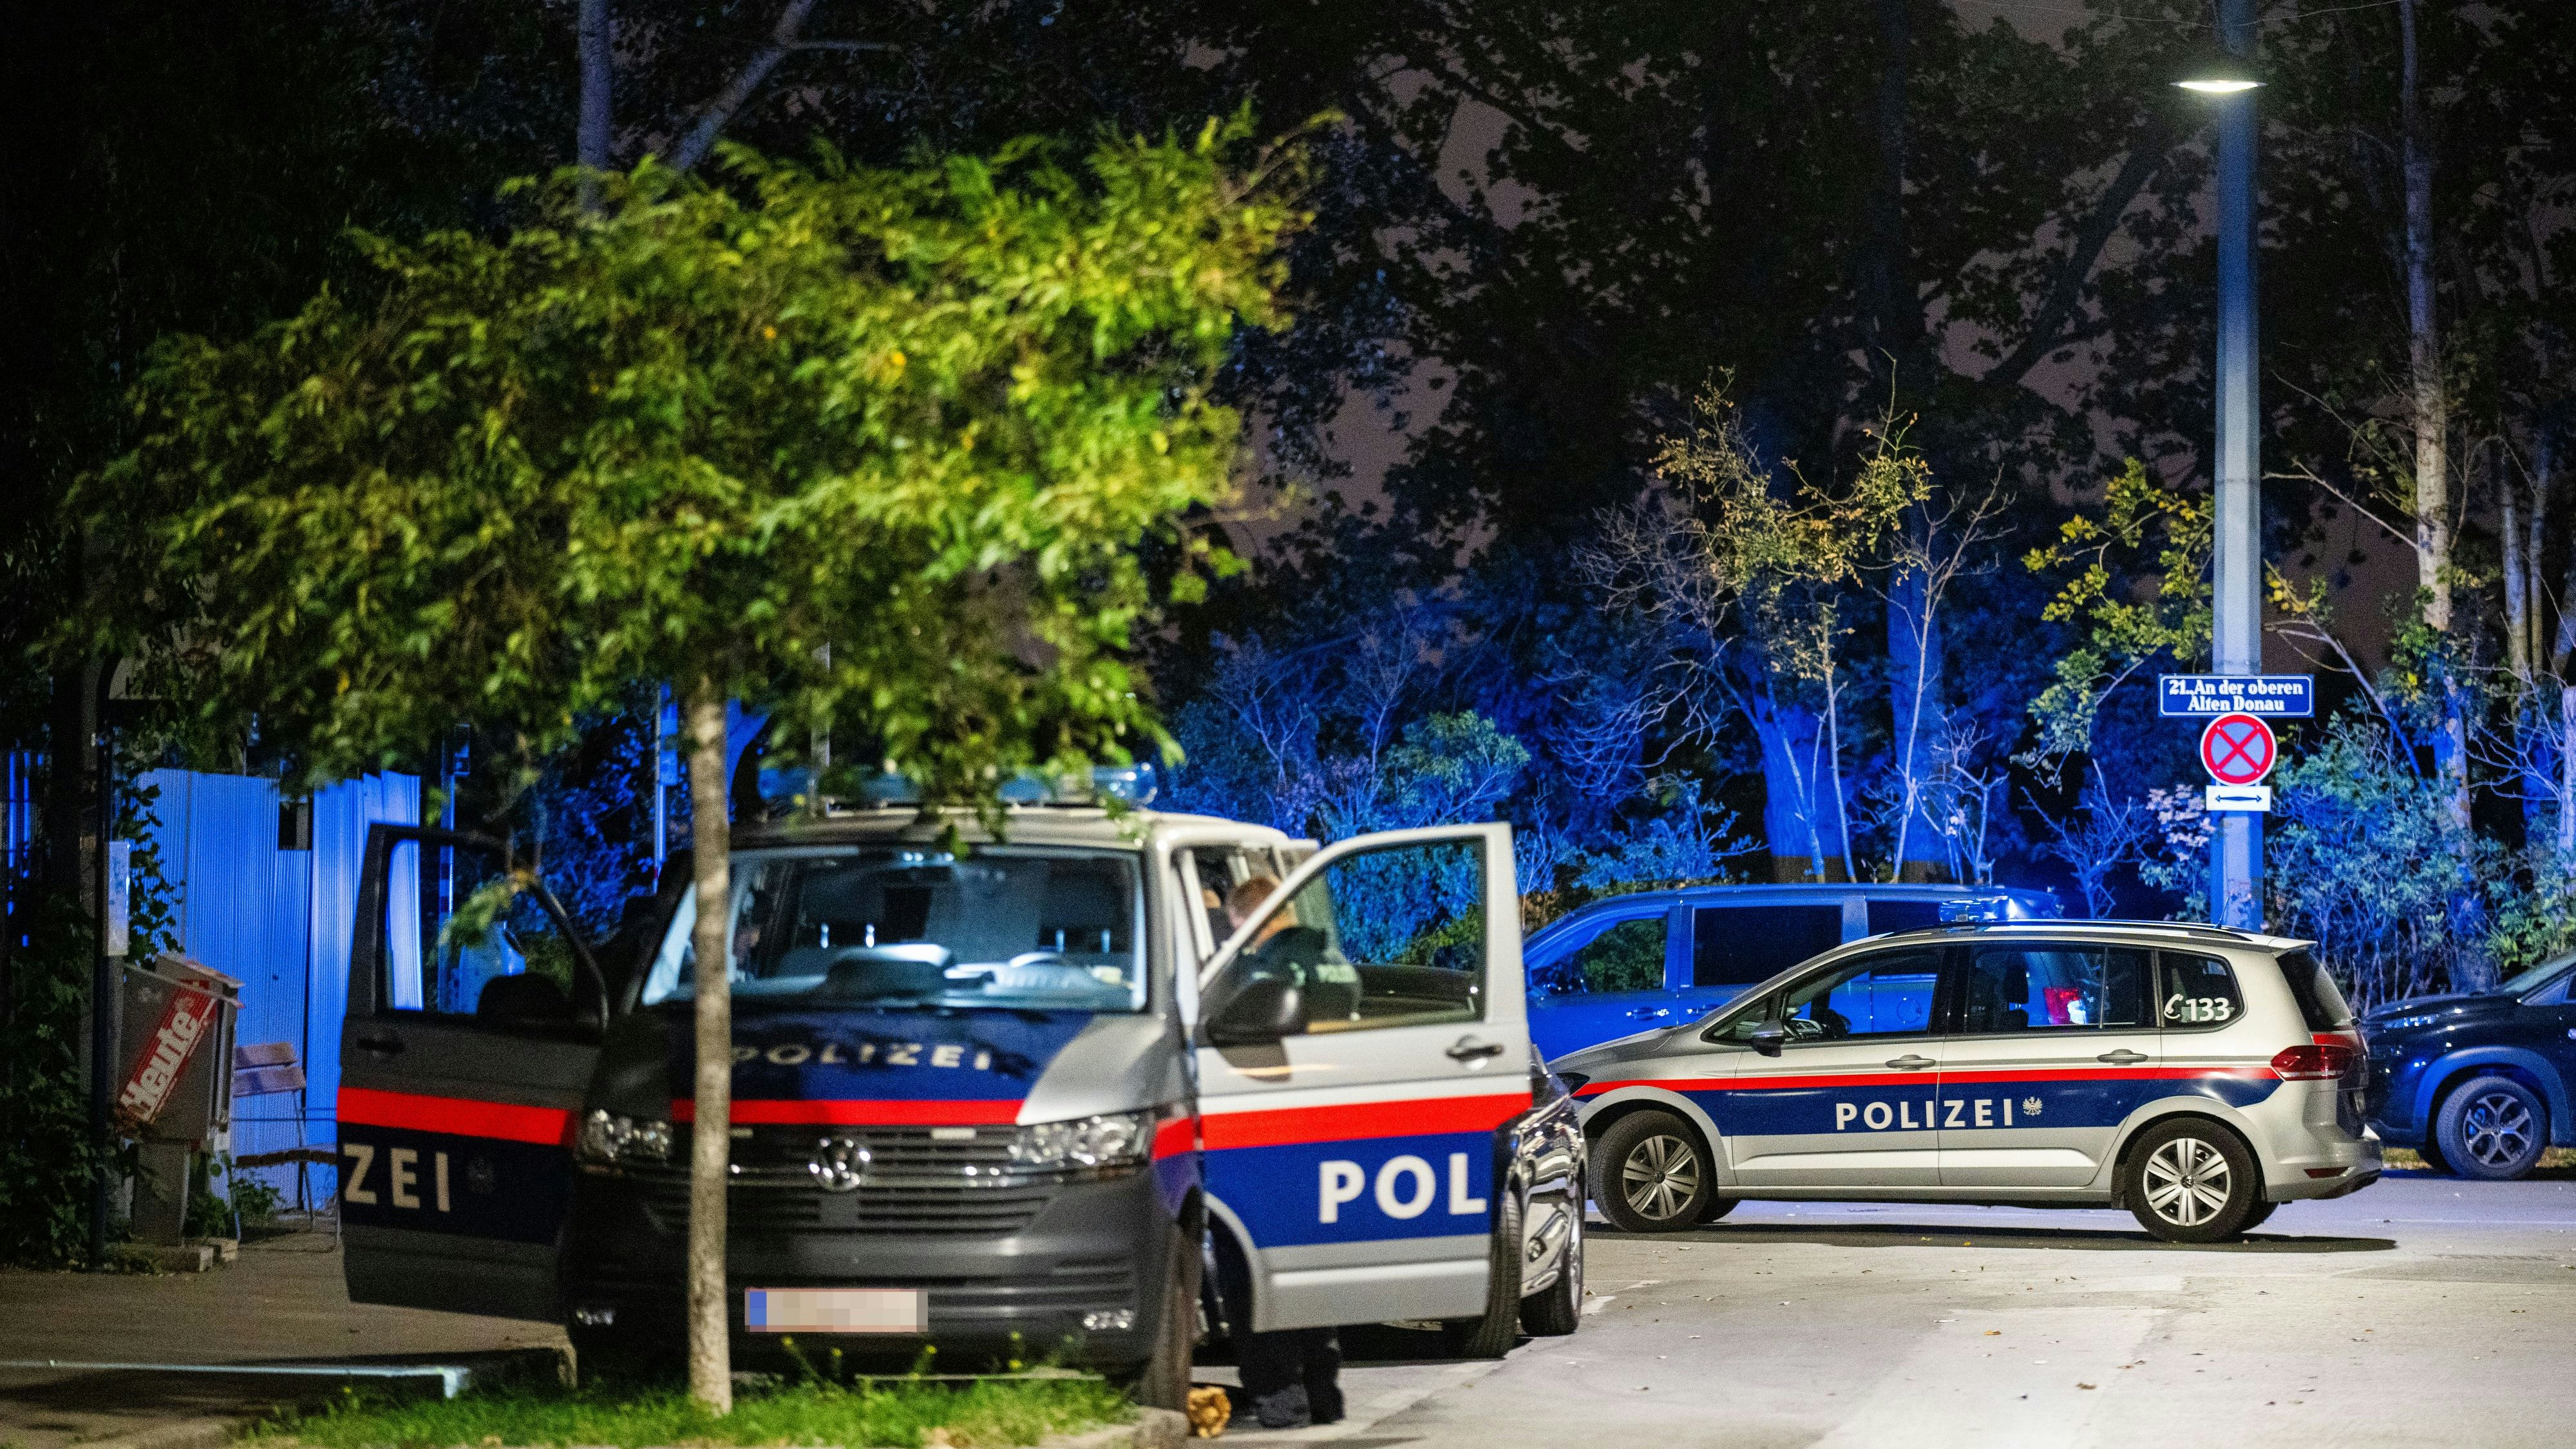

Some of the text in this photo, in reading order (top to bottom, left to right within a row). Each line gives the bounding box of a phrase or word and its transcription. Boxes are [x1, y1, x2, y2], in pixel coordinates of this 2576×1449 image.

[2219, 679, 2245, 695] der
[2248, 679, 2304, 695] oberen
[2187, 695, 2285, 711] Alten Donau
[2185, 997, 2230, 1021] 133
[120, 1010, 200, 1119] Heute
[1836, 1099, 2012, 1130] POLIZEI
[343, 1142, 450, 1213] ZEI
[1319, 1153, 1487, 1223] POL
